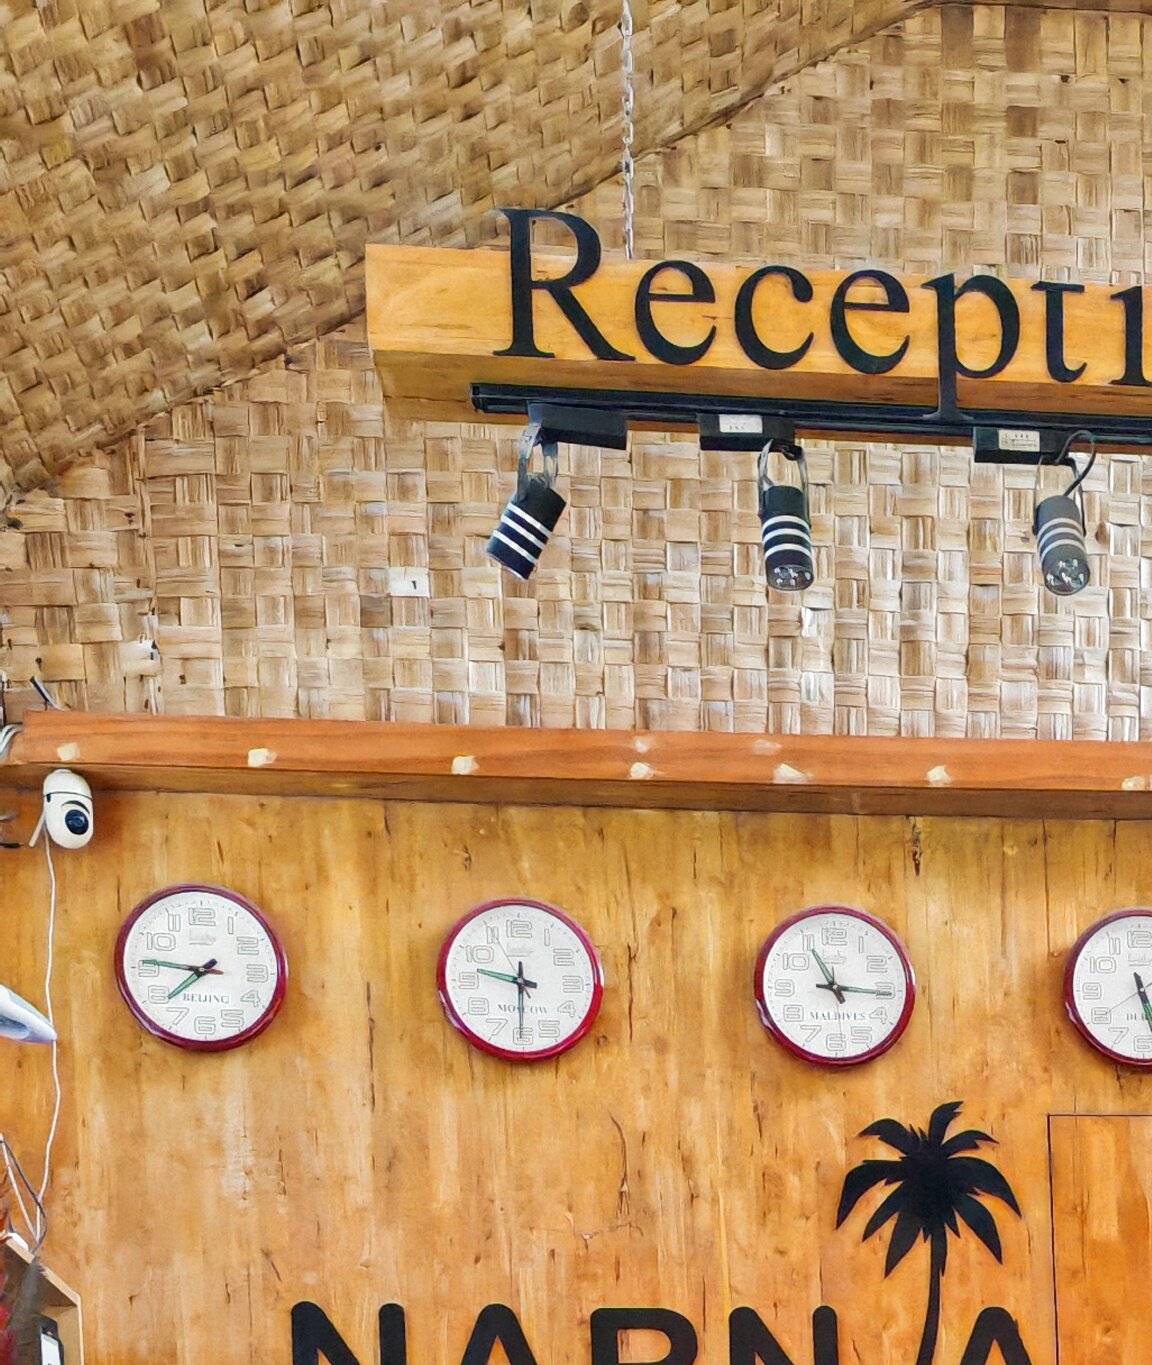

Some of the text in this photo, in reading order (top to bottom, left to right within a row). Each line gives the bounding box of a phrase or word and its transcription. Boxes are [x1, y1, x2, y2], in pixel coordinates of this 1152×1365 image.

[168, 914, 180, 932] 11
[188, 908, 215, 926] 12
[228, 916, 233, 934] 1
[487, 926, 498, 944] 11
[506, 920, 532, 938] 12
[544, 929, 550, 946] 1
[822, 928, 847, 946] 12
[147, 932, 176, 951] 10
[237, 937, 259, 955] 2
[803, 934, 814, 951] 11
[859, 936, 864, 953] 1
[1109, 938, 1120, 955] 11
[1127, 931, 1152, 948] 12
[466, 945, 494, 963] 10
[554, 949, 574, 966] 2
[783, 953, 809, 970] 10
[138, 960, 159, 977] 9
[867, 955, 887, 973] 2
[1090, 956, 1116, 973] 10
[247, 964, 268, 982] 3
[459, 972, 479, 989] 9
[563, 975, 583, 993] 3
[775, 979, 794, 997] 9
[875, 982, 895, 999] 3
[1083, 983, 1101, 1000] 9
[148, 985, 169, 1004] 8
[183, 994, 229, 1004] BEIJING
[241, 990, 259, 1007] 4
[468, 997, 488, 1015] 8
[558, 1001, 576, 1017] 4
[783, 1005, 803, 1022] 8
[167, 1007, 189, 1026] 7
[221, 1009, 243, 1028] 5
[810, 1012, 865, 1020] MALDIVES
[869, 1007, 887, 1024] 4
[1091, 1007, 1111, 1024] 8
[194, 1016, 215, 1034] 6
[486, 1019, 508, 1036] 7
[538, 1020, 559, 1038] 5
[800, 1025, 822, 1042] 7
[513, 1027, 533, 1045] 6
[826, 1034, 846, 1051] 6
[851, 1026, 872, 1043] 5
[1108, 1027, 1129, 1044] 7
[1134, 1035, 1152, 1052] 6
